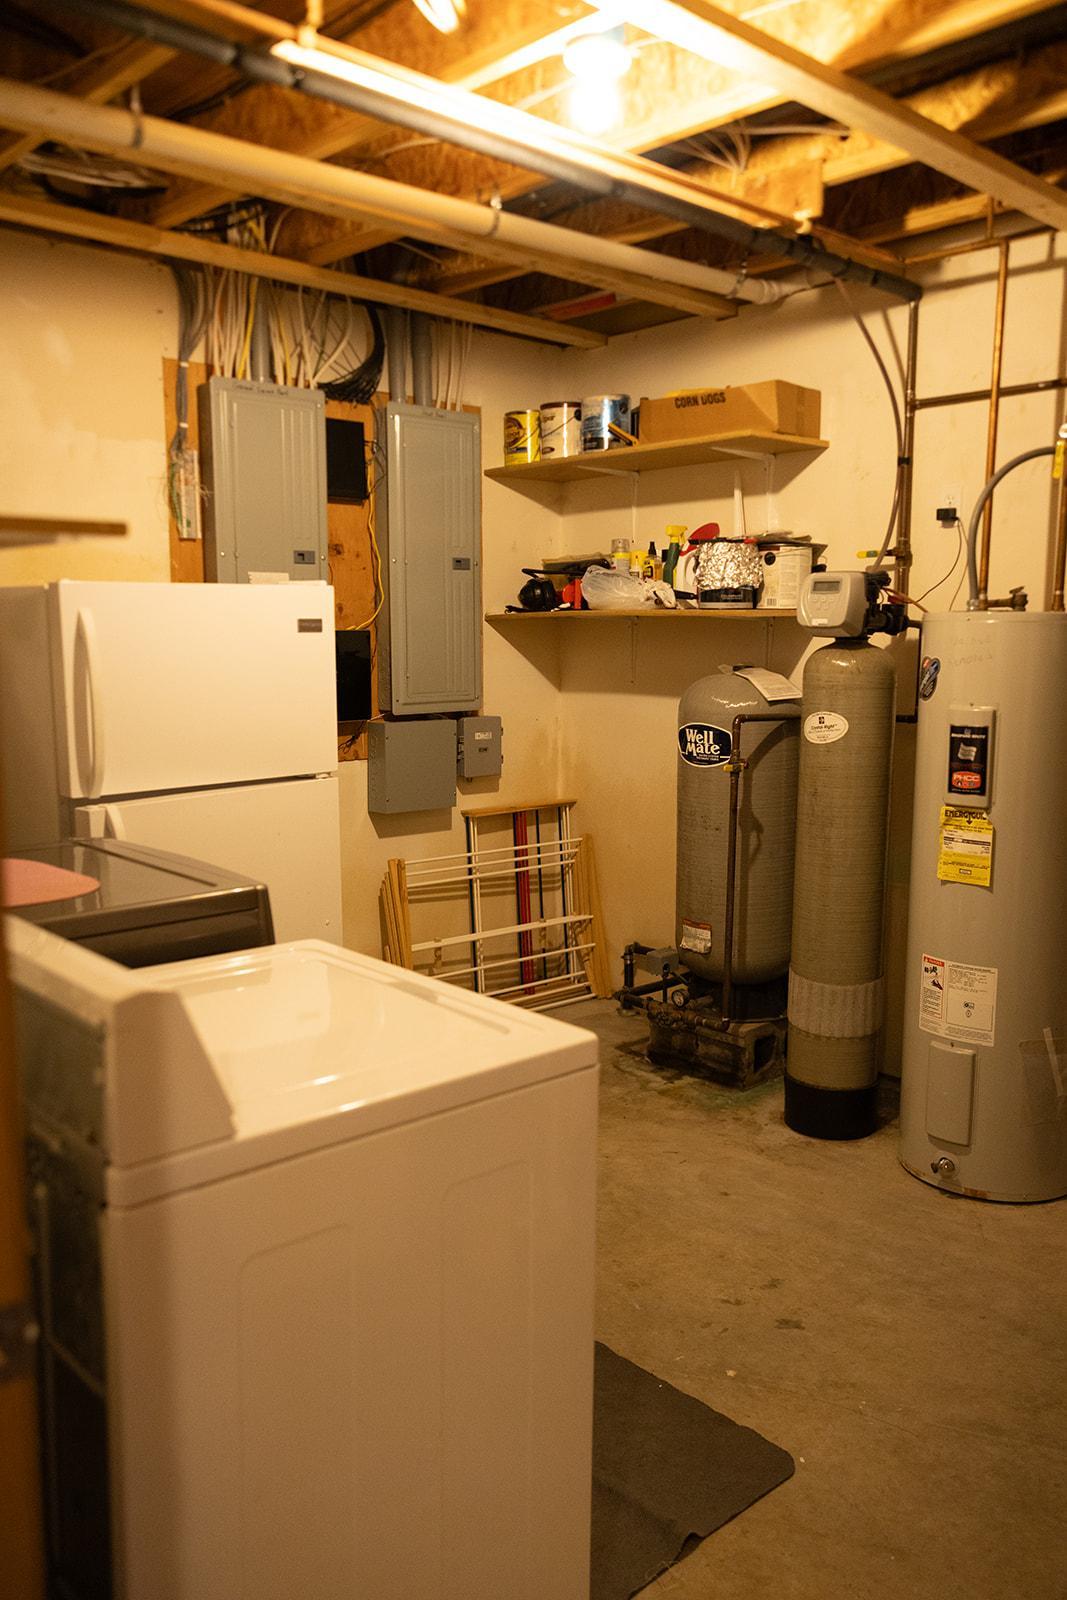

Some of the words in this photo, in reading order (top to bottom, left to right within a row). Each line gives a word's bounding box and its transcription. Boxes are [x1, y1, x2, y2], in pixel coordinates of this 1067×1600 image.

[674, 396, 699, 408] CORN
[701, 391, 726, 405] DOGS
[685, 729, 714, 744] Well
[685, 742, 721, 757] Mate
